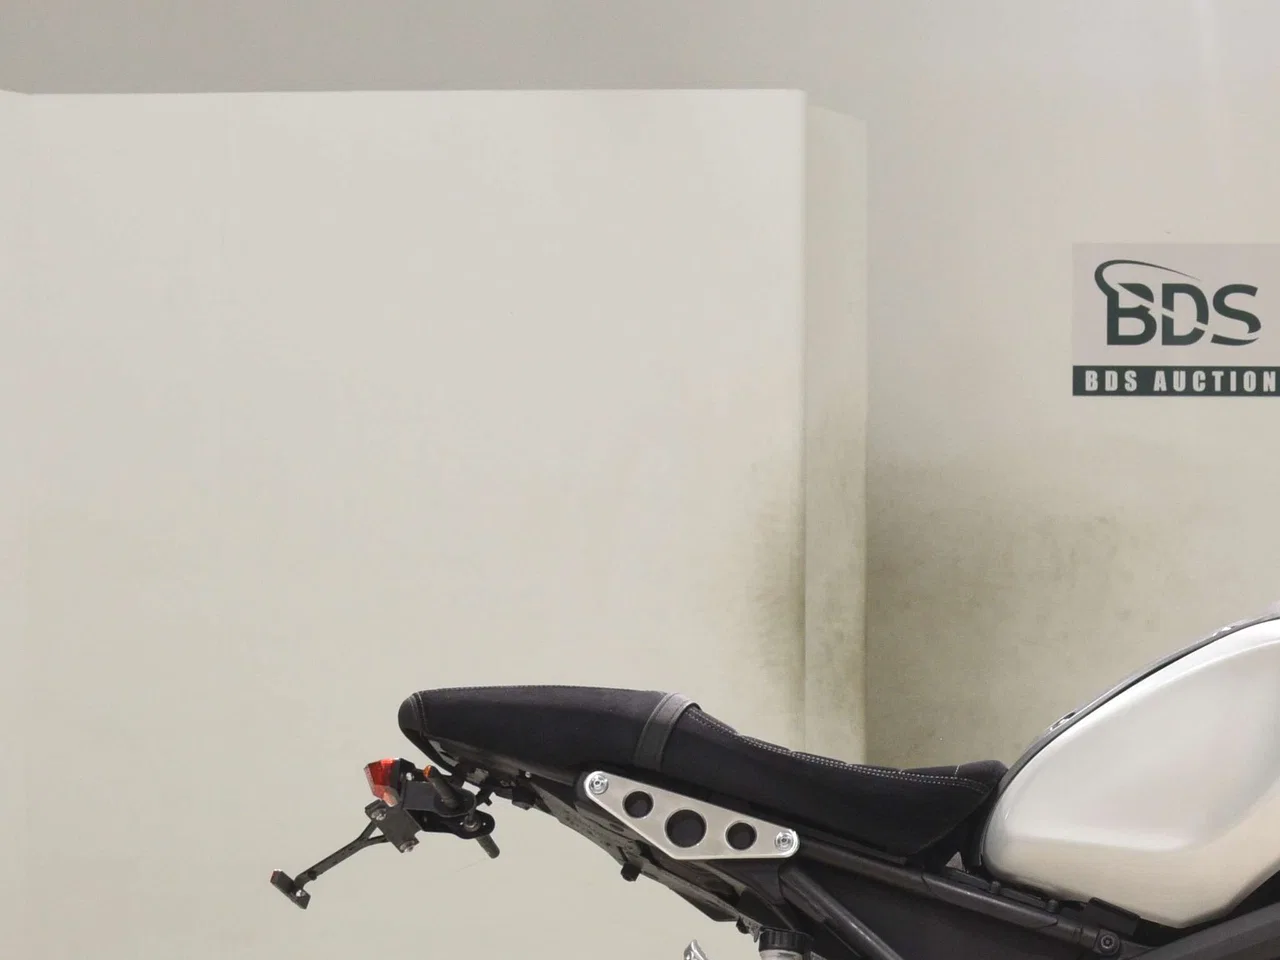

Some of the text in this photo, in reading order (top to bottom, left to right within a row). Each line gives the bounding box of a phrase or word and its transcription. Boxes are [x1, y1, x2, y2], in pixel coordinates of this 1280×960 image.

[1095, 260, 1261, 346] BDS
[1085, 370, 1277, 392] BDS AUCTION
